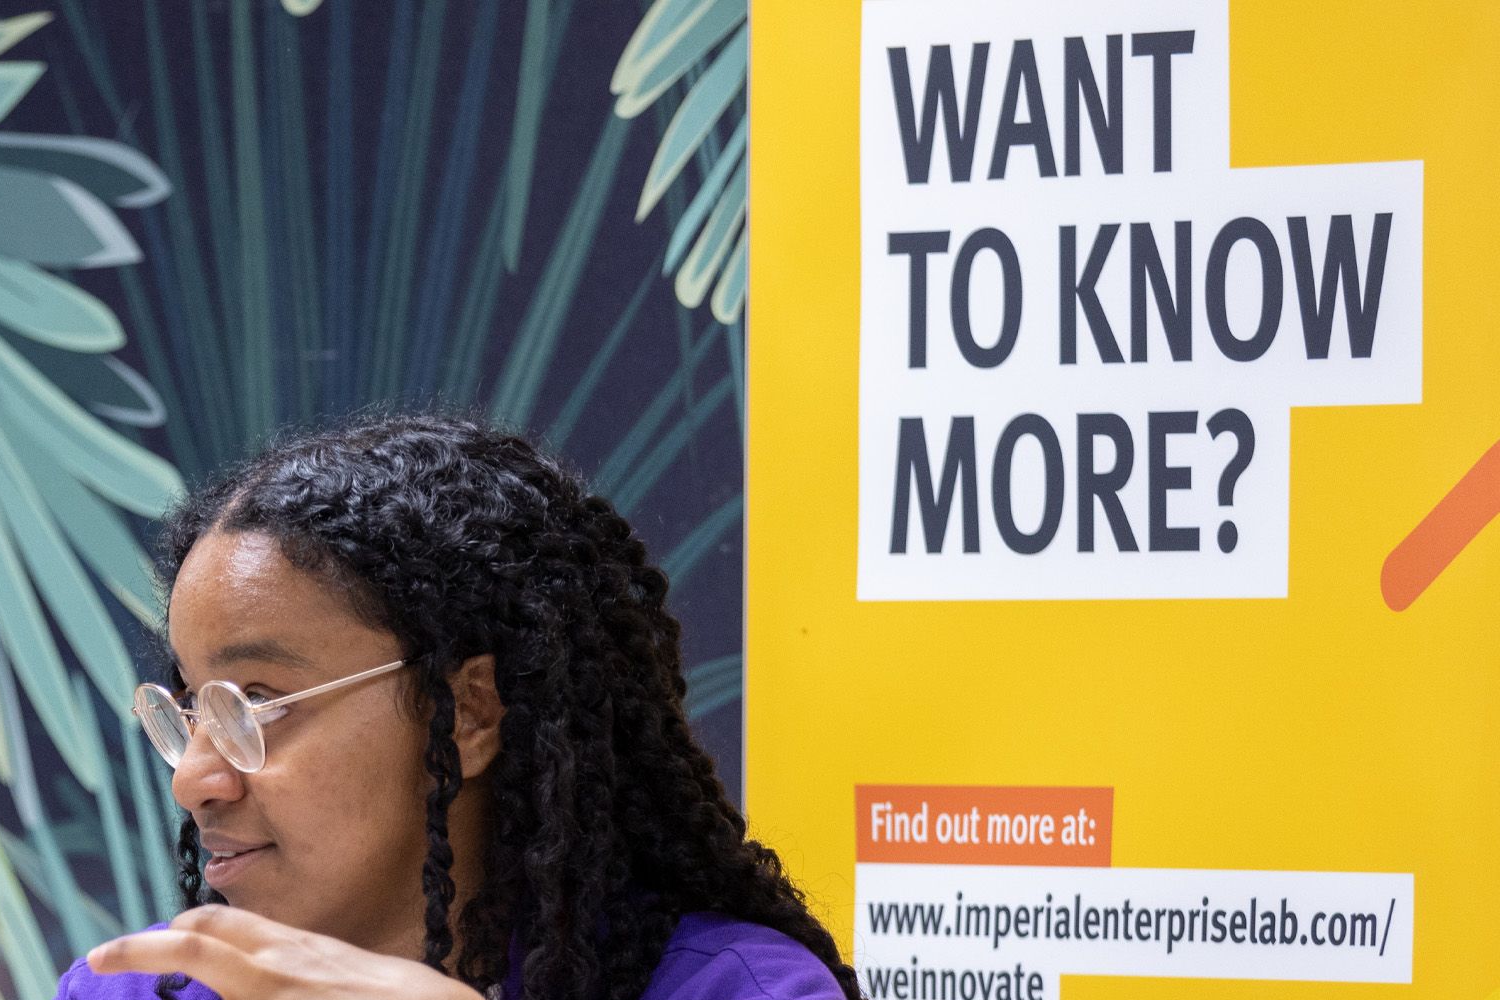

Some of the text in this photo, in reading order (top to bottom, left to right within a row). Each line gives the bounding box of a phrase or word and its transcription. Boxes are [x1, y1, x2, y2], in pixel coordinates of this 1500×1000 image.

[886, 30, 1196, 185] WANT
[887, 212, 1393, 369] TO KNOW
[888, 408, 1256, 556] MORE?
[871, 801, 1097, 846] Find out more at:
[867, 891, 1396, 956] www.imperialenterpriselab.com/
